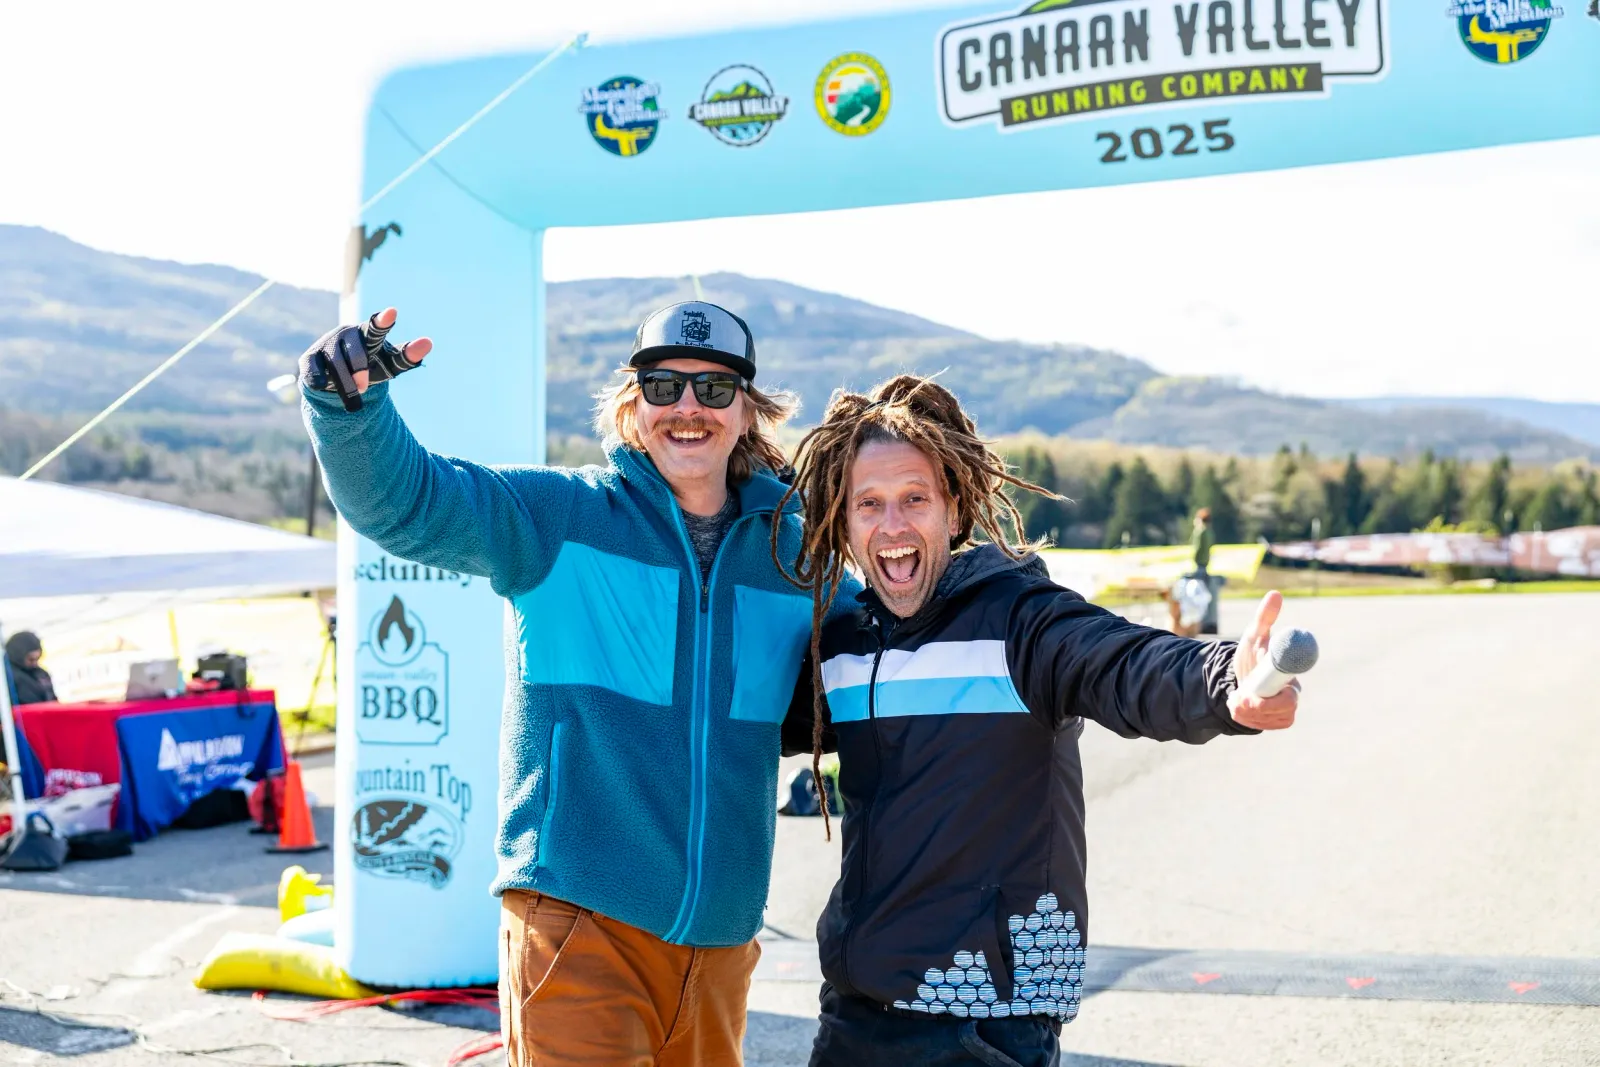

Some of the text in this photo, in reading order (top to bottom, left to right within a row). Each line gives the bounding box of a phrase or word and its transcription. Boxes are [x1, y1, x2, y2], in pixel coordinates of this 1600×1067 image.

[957, 0, 1361, 92] CANAAN VALLEY
[1011, 66, 1309, 122] RUNNING COMPANY
[1096, 119, 1235, 163] 2025
[361, 685, 442, 726] BBQ
[430, 764, 472, 823] Top
